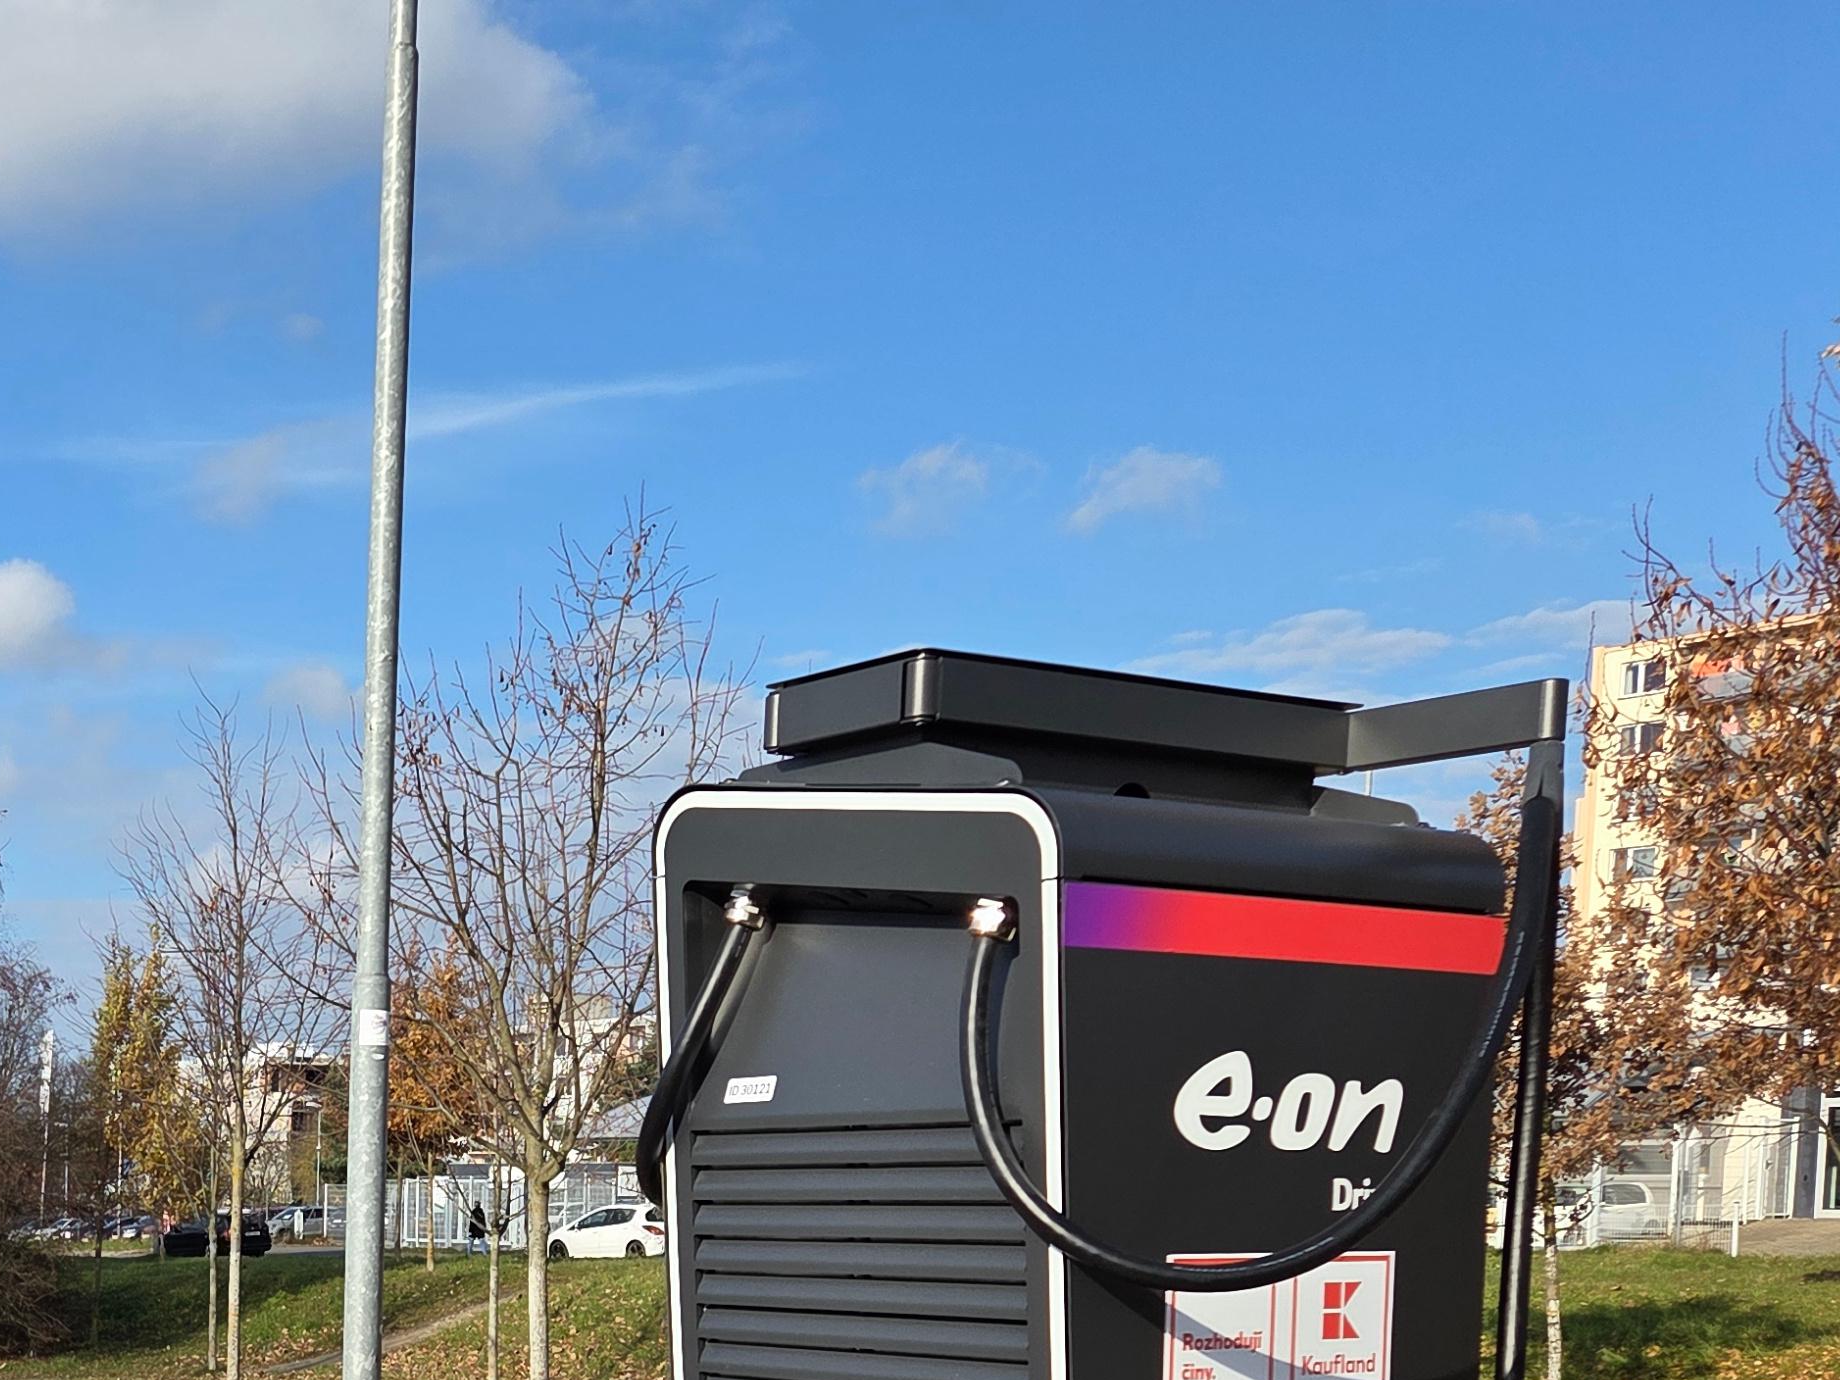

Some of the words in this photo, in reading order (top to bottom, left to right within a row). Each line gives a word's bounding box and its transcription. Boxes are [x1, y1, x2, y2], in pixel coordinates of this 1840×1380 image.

[729, 1085, 740, 1096] ID
[740, 1083, 771, 1096] 30121
[1331, 1177, 1377, 1212] Dri
[1182, 1330, 1263, 1354] Rozhodují
[1301, 1353, 1377, 1377] Kaufland
